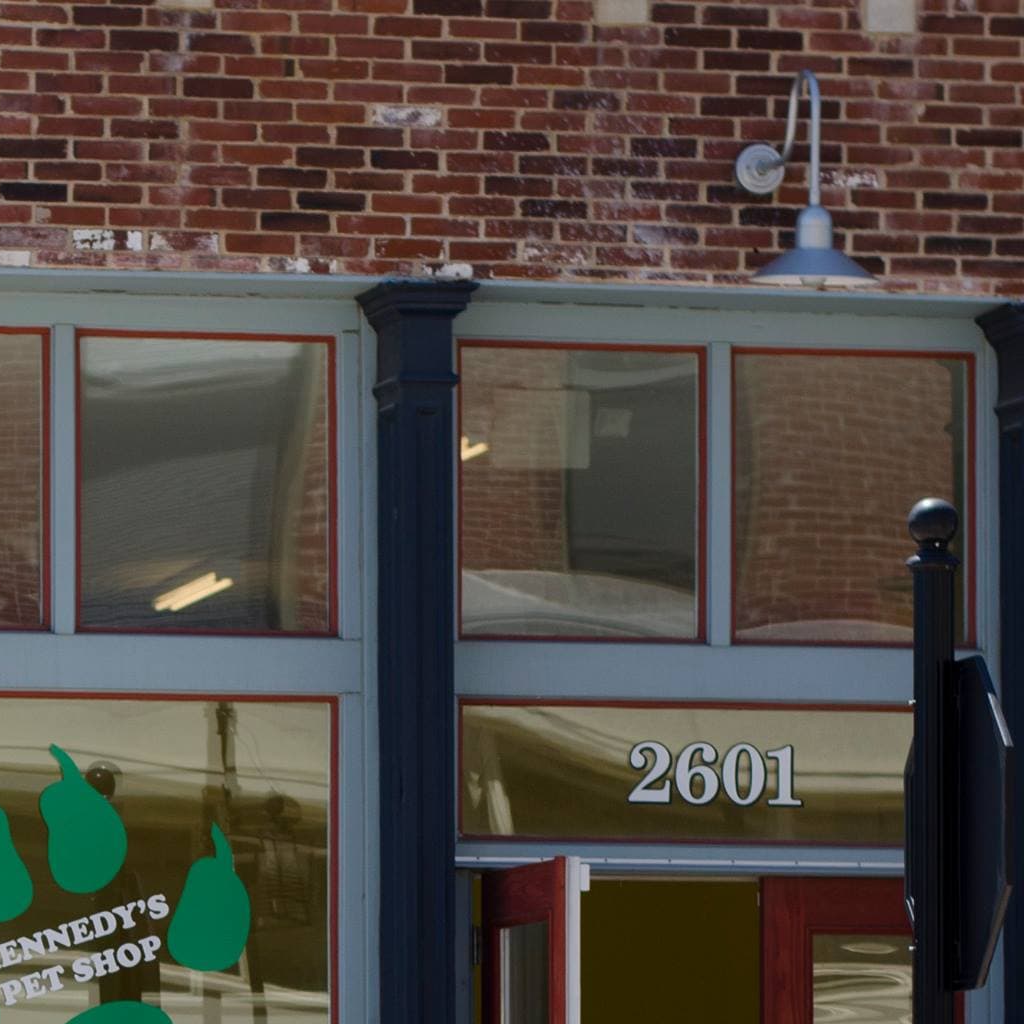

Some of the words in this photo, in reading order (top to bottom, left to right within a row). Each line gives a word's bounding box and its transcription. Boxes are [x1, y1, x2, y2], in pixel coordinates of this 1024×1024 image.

[628, 741, 803, 807] 2601
[0, 965, 65, 1006] PET
[71, 935, 162, 983] SHOP
